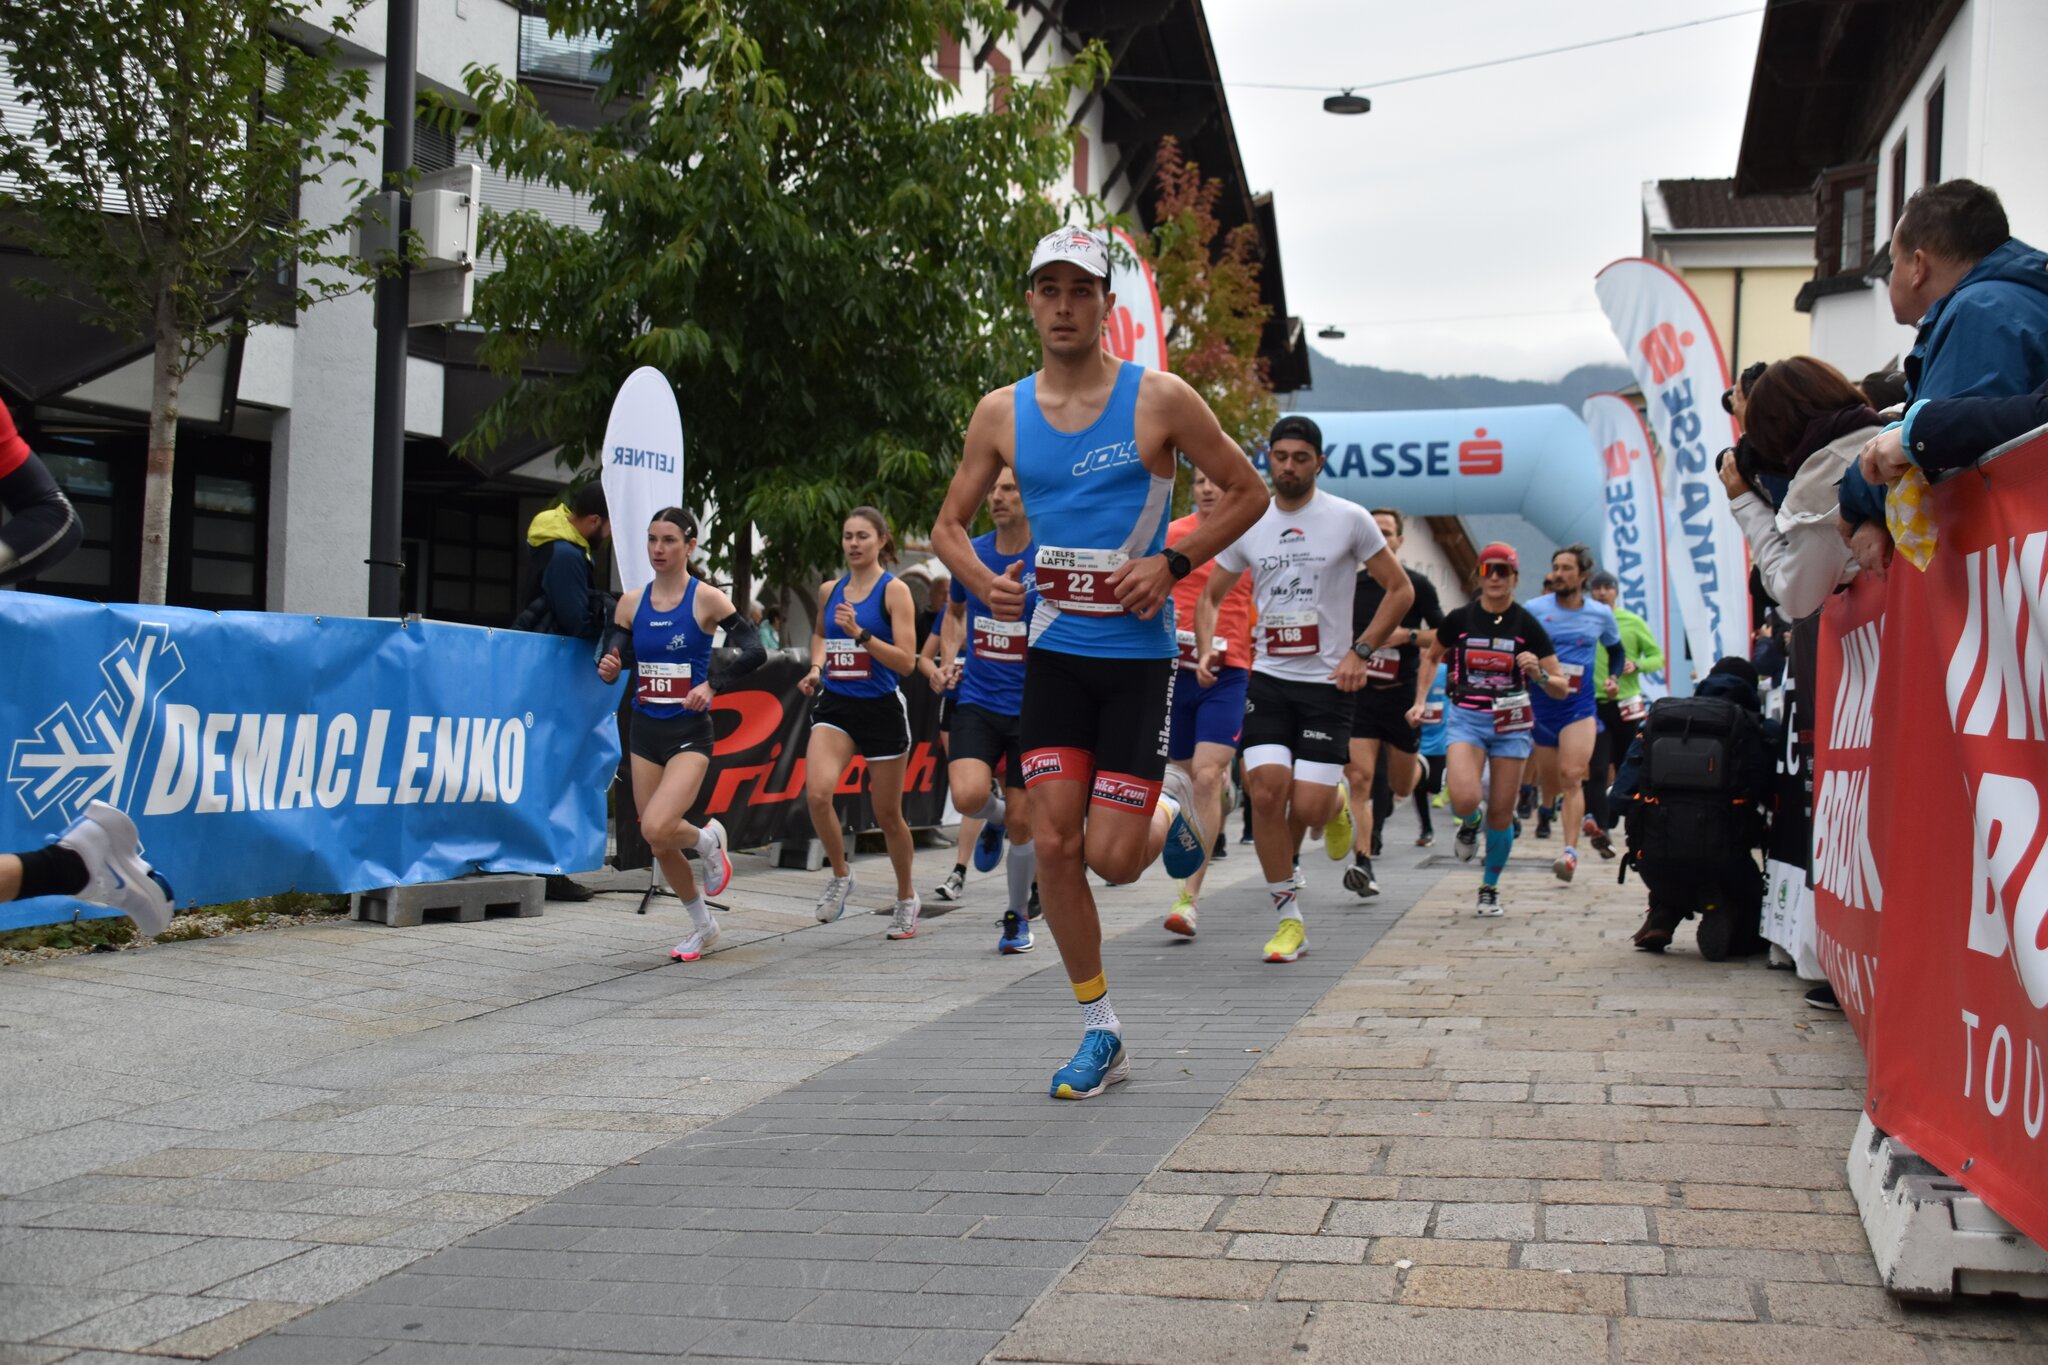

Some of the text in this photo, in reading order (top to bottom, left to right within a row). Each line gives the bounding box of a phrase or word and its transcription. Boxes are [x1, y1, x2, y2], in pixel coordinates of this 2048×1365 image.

[1052, 550, 1076, 558] TELFS
[1041, 557, 1076, 567] LAFT'S
[1067, 572, 1095, 594] 22
[987, 634, 1010, 649] 160
[1277, 628, 1303, 643] 168
[833, 653, 855, 666] 163
[649, 678, 672, 692] 161
[1036, 758, 1058, 770] run
[1124, 787, 1146, 800] run
